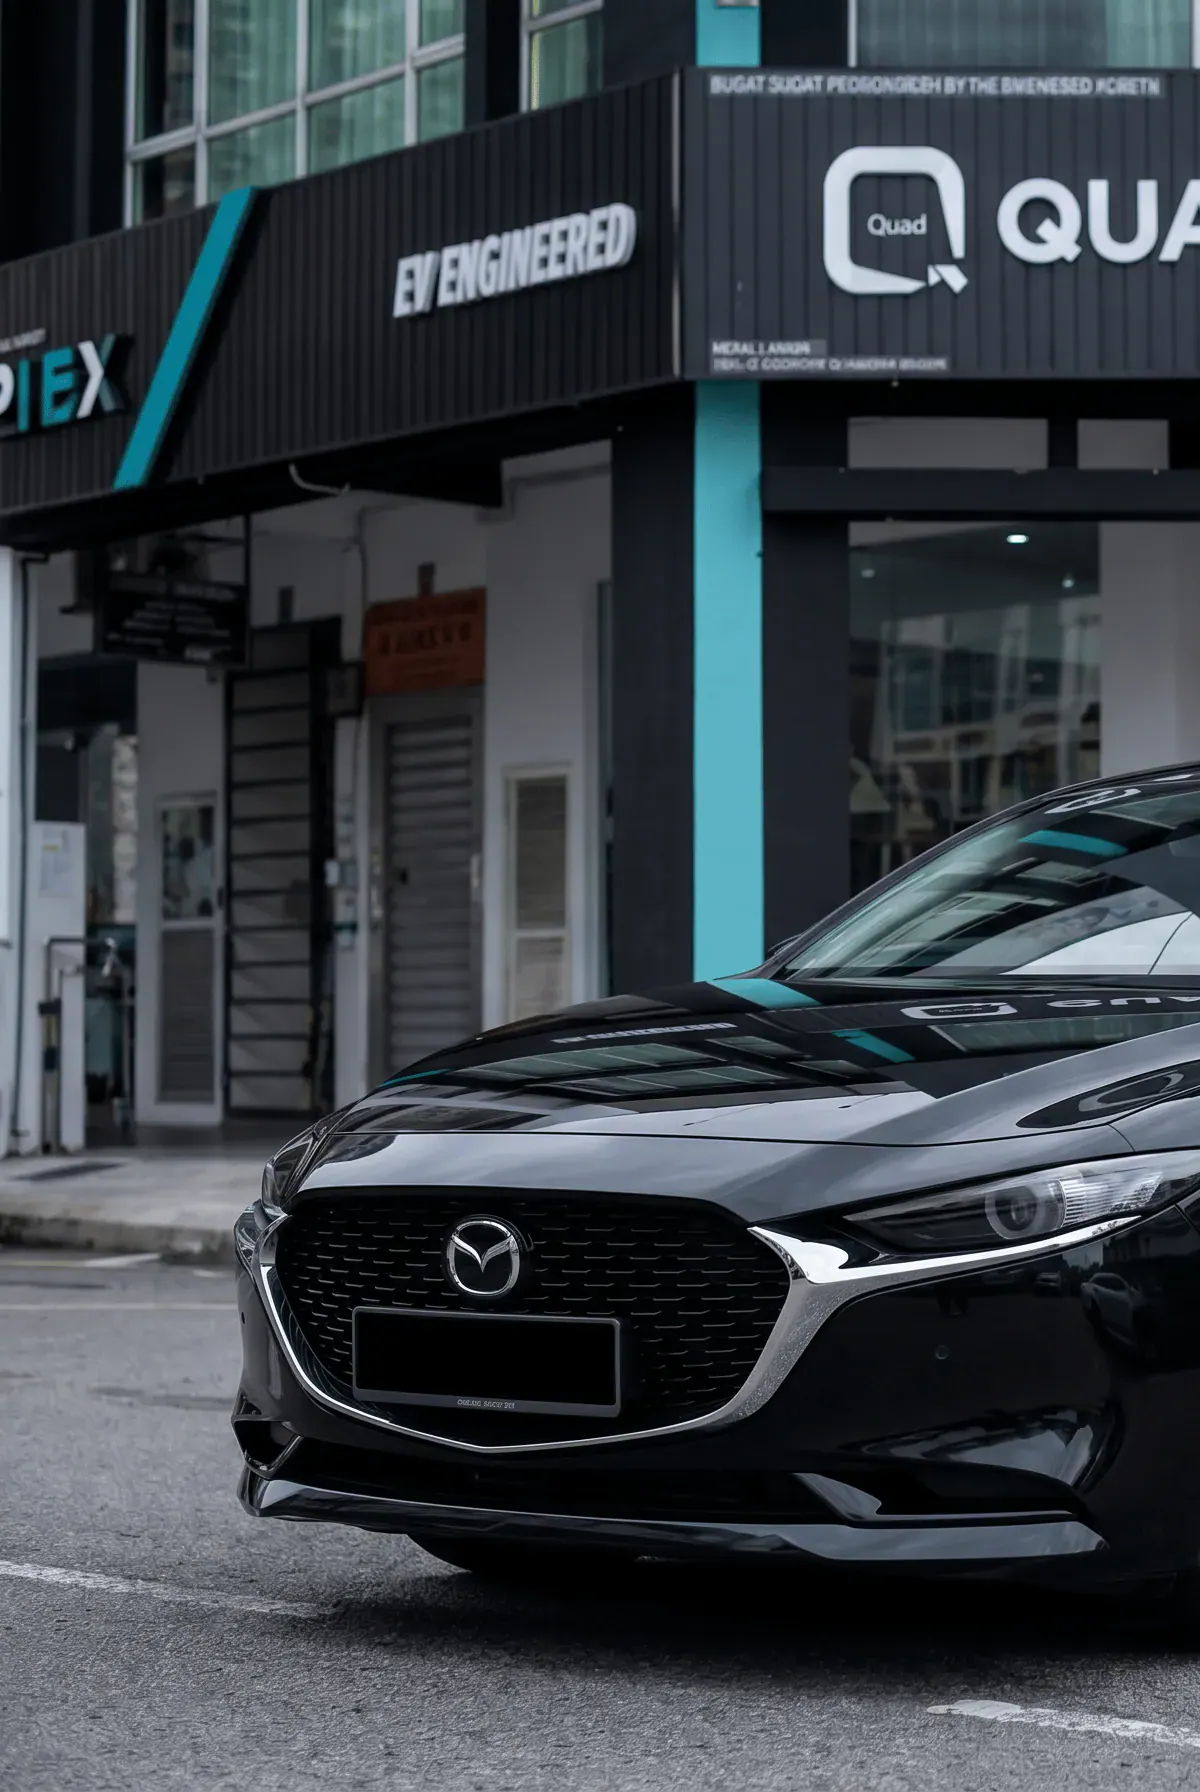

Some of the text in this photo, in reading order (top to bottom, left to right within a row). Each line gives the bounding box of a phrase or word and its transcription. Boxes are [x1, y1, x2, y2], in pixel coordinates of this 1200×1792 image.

[393, 202, 636, 318] EV ENGINEERED
[867, 213, 927, 237] Quad
